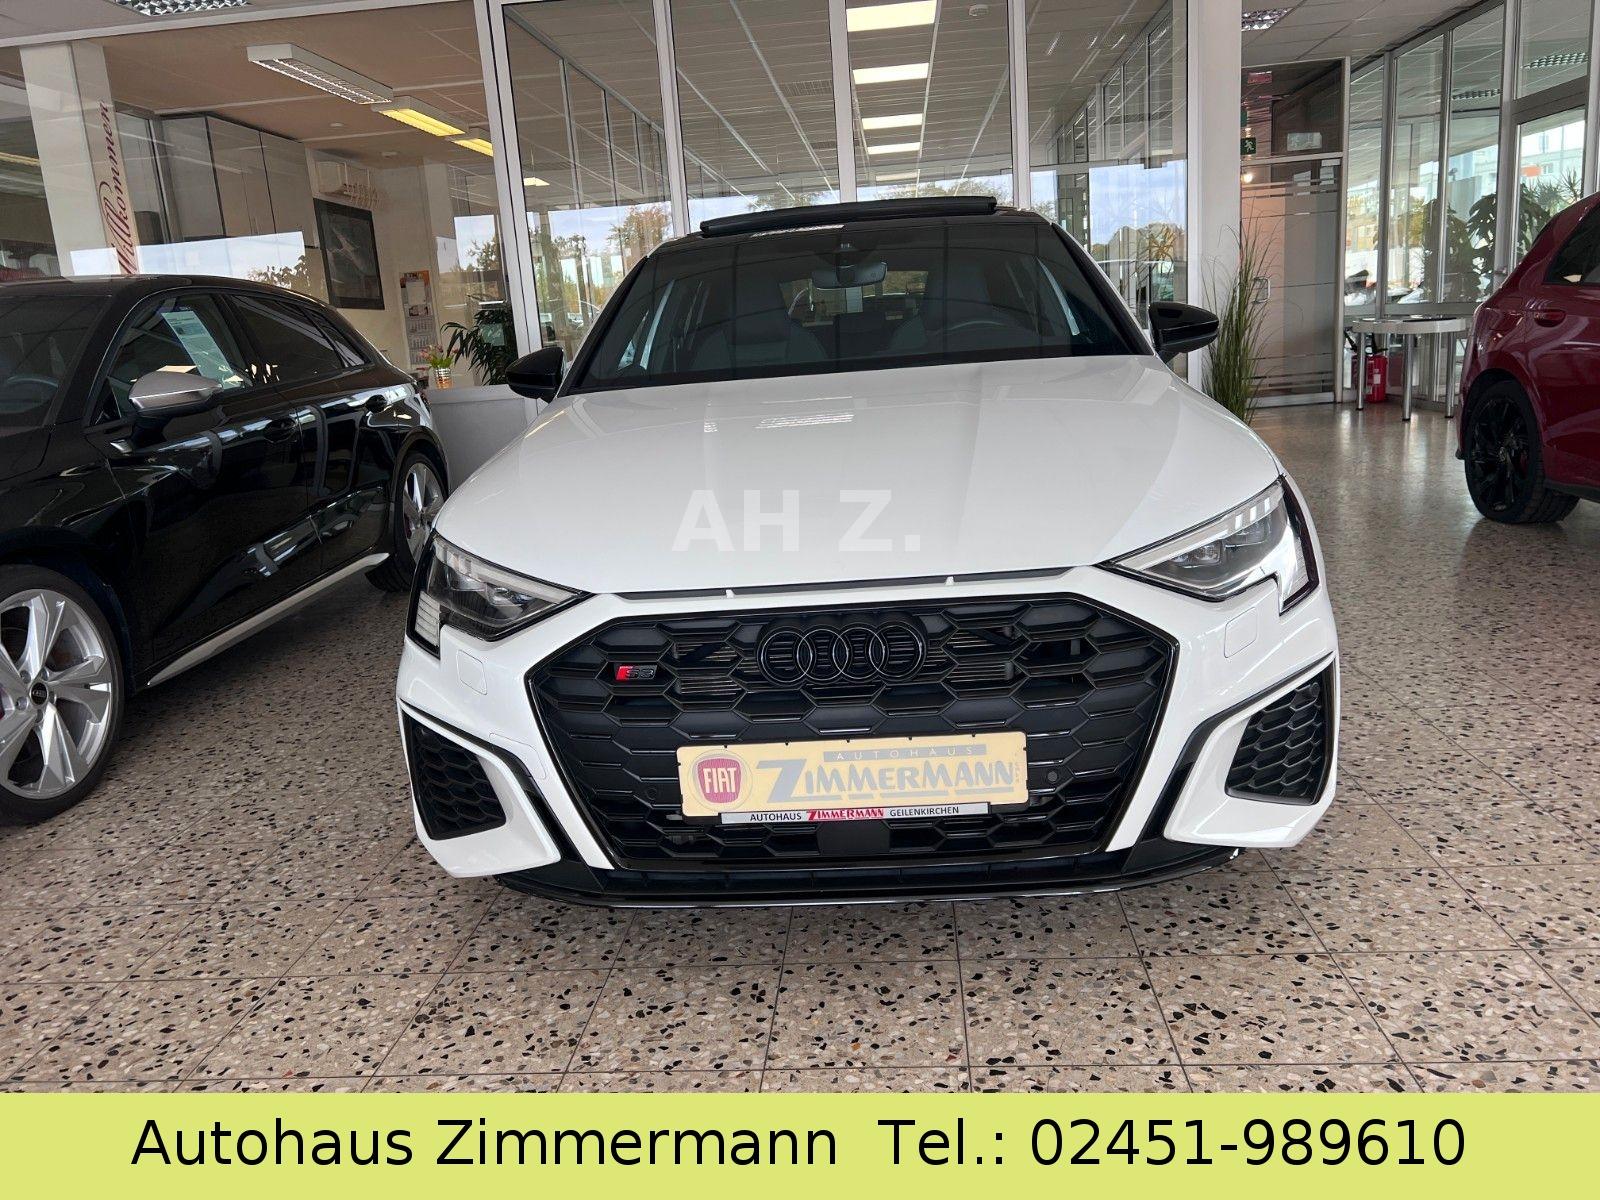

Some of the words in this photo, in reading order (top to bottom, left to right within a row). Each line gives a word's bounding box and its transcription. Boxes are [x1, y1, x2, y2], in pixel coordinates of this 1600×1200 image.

[100, 101, 138, 274] Willkommen
[837, 744, 973, 761] AUTOHAUS
[703, 766, 738, 794] FIAT
[756, 759, 1014, 803] ZIMMERMANN
[750, 812, 802, 822] AUTOHAUS
[807, 808, 884, 823] ZIMMERMANN
[889, 806, 960, 817] GEILENKIRCHEN
